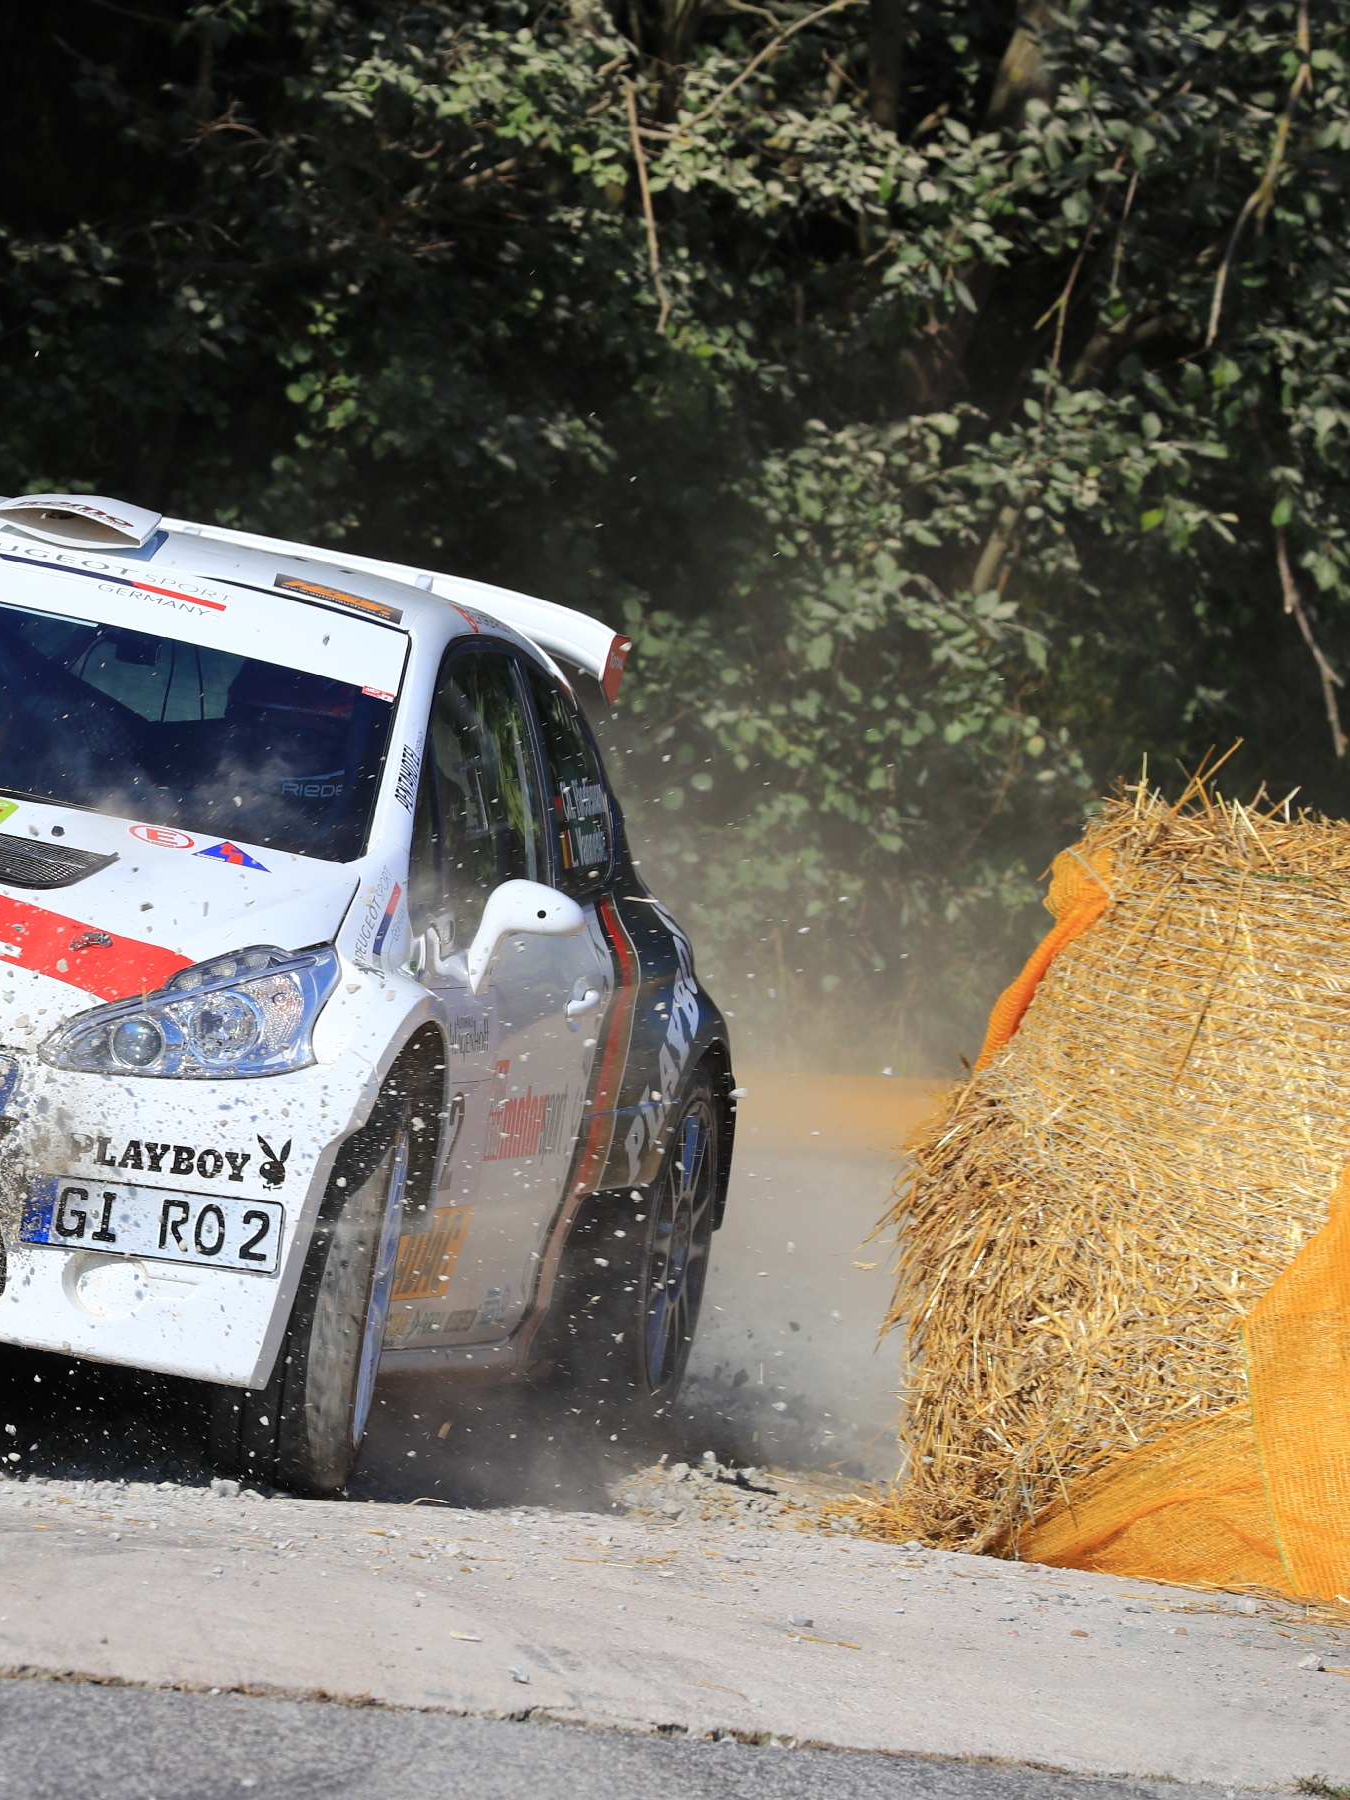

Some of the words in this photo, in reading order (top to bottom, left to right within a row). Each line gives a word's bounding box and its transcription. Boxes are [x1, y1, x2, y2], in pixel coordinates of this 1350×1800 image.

[97, 583, 210, 617] GERMANY
[144, 573, 236, 603] SPORT
[354, 895, 381, 962] PEUGEOT
[375, 864, 393, 902] SPORT
[70, 1131, 252, 1183] PLAYBOY
[54, 1185, 118, 1244] GI
[157, 1198, 226, 1257] RO
[237, 1209, 271, 1262] 2
